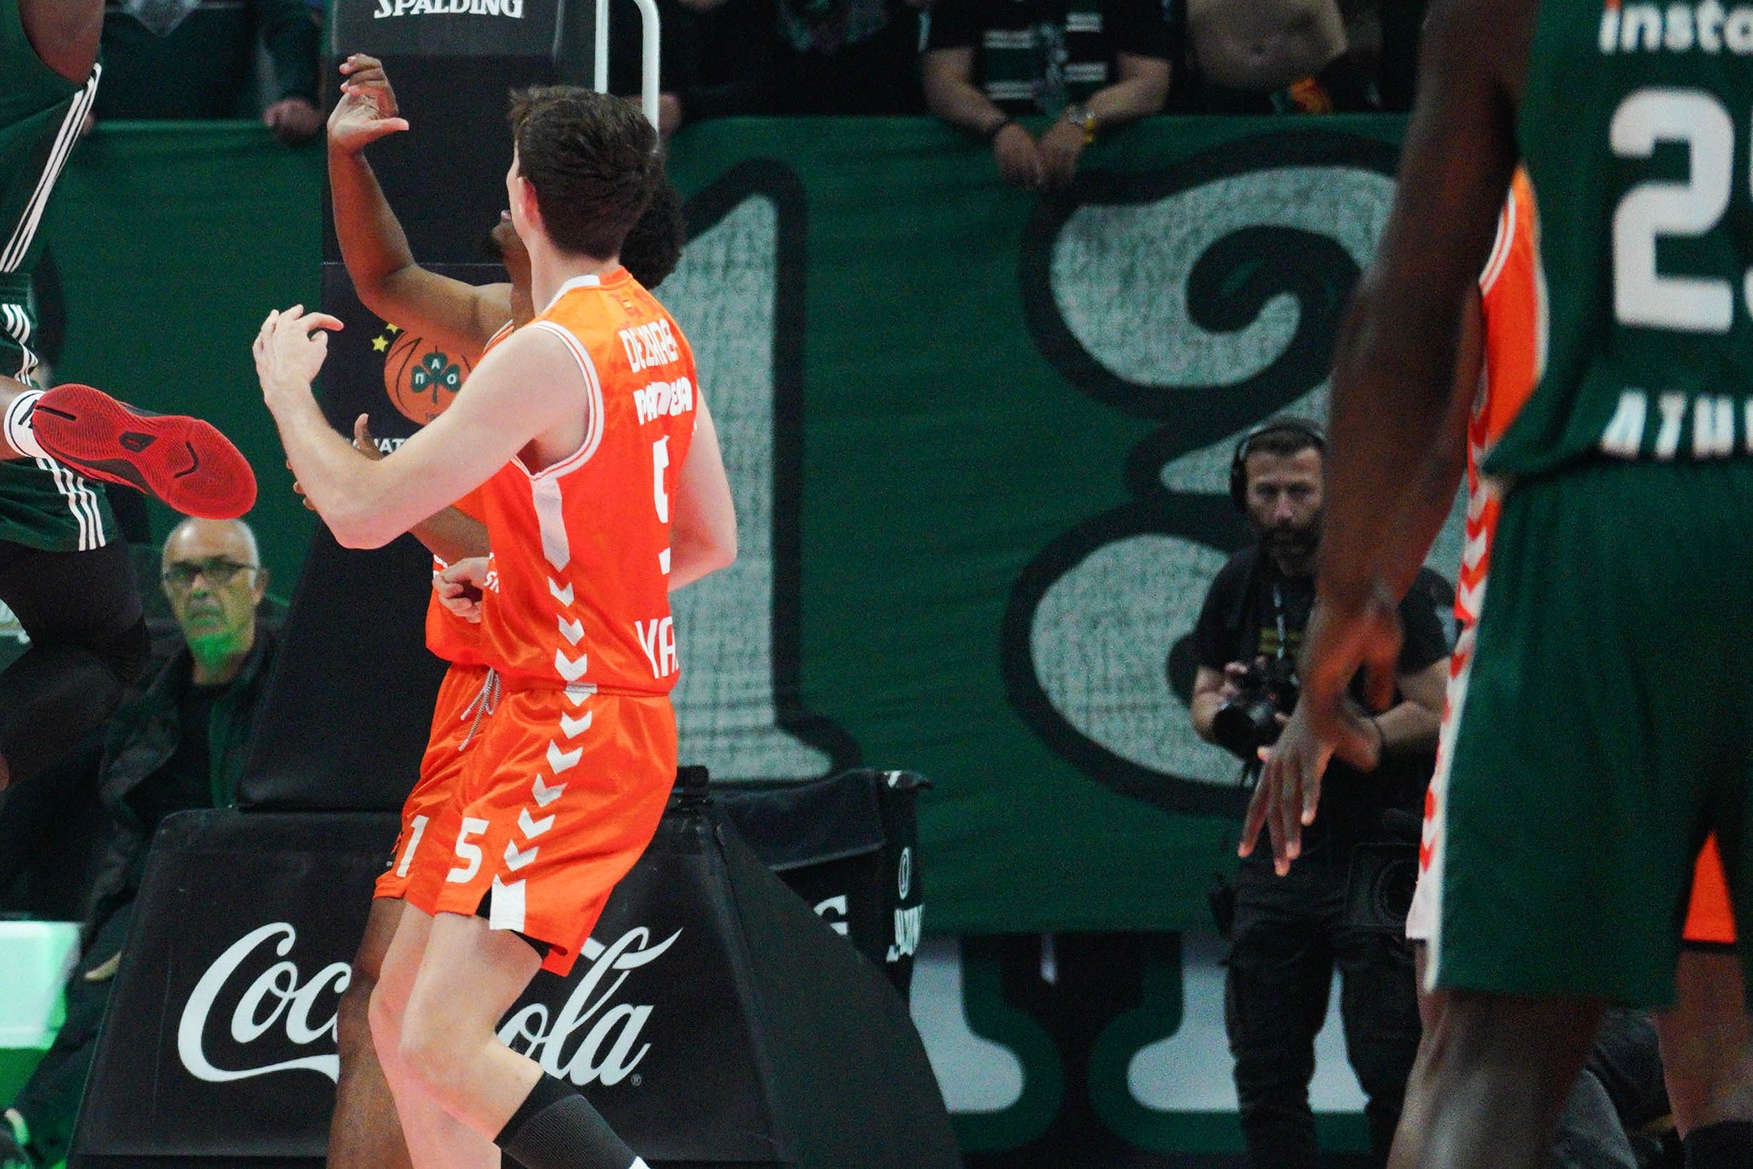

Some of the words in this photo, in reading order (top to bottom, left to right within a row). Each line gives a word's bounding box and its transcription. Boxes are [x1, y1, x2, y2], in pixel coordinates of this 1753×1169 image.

[1609, 88, 1753, 333] 2
[1600, 389, 1753, 461] ATH
[634, 616, 678, 680] VA
[445, 816, 489, 884] 5
